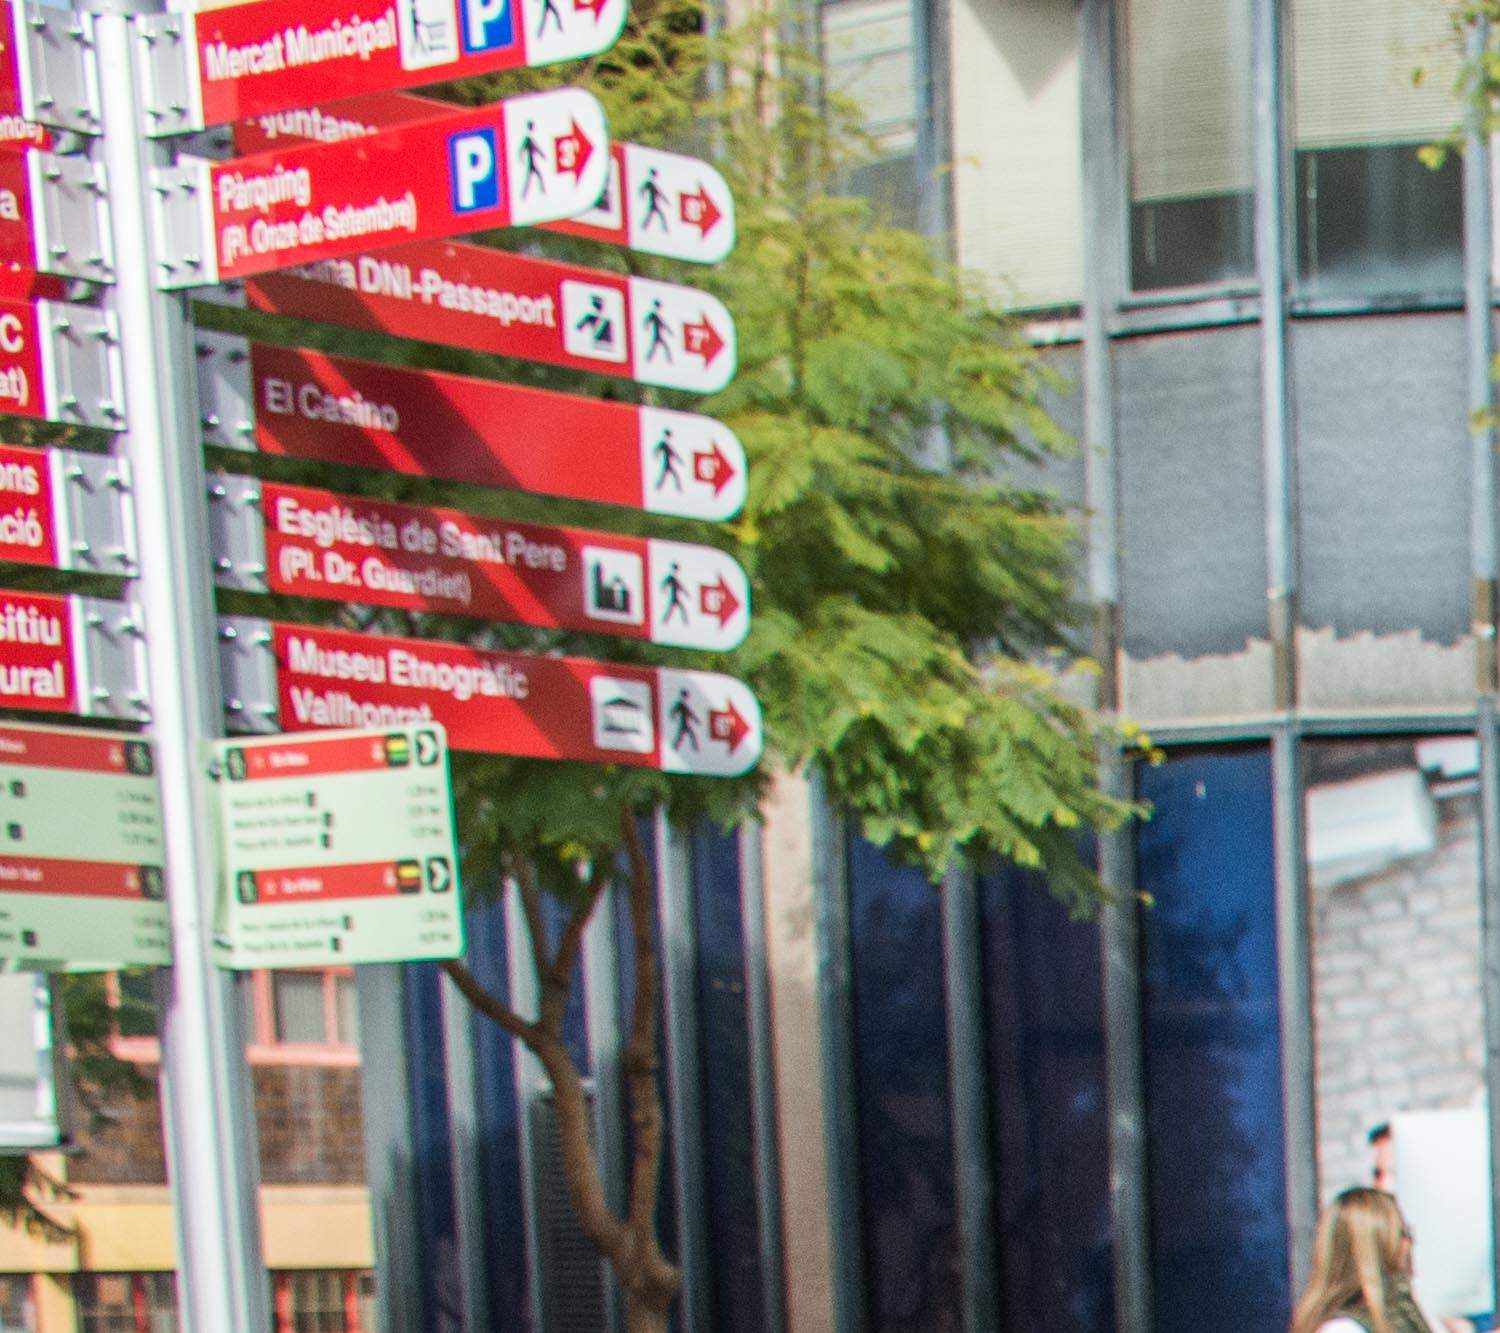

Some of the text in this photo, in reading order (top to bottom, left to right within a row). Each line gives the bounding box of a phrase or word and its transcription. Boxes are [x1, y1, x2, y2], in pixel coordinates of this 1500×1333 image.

[205, 8, 397, 80] Mercat Municipal
[219, 164, 311, 213] Pàrquing
[223, 191, 417, 267] (Pl. Onze de Setembre)
[358, 256, 556, 328] DNI-Passaport
[264, 376, 399, 432] El Casino
[279, 544, 322, 583] (Pl.
[323, 551, 361, 586] Dr.
[401, 518, 437, 554] de
[439, 520, 504, 563] Sant
[506, 531, 567, 572] Pere
[287, 636, 529, 701] Museu Etnogràfic
